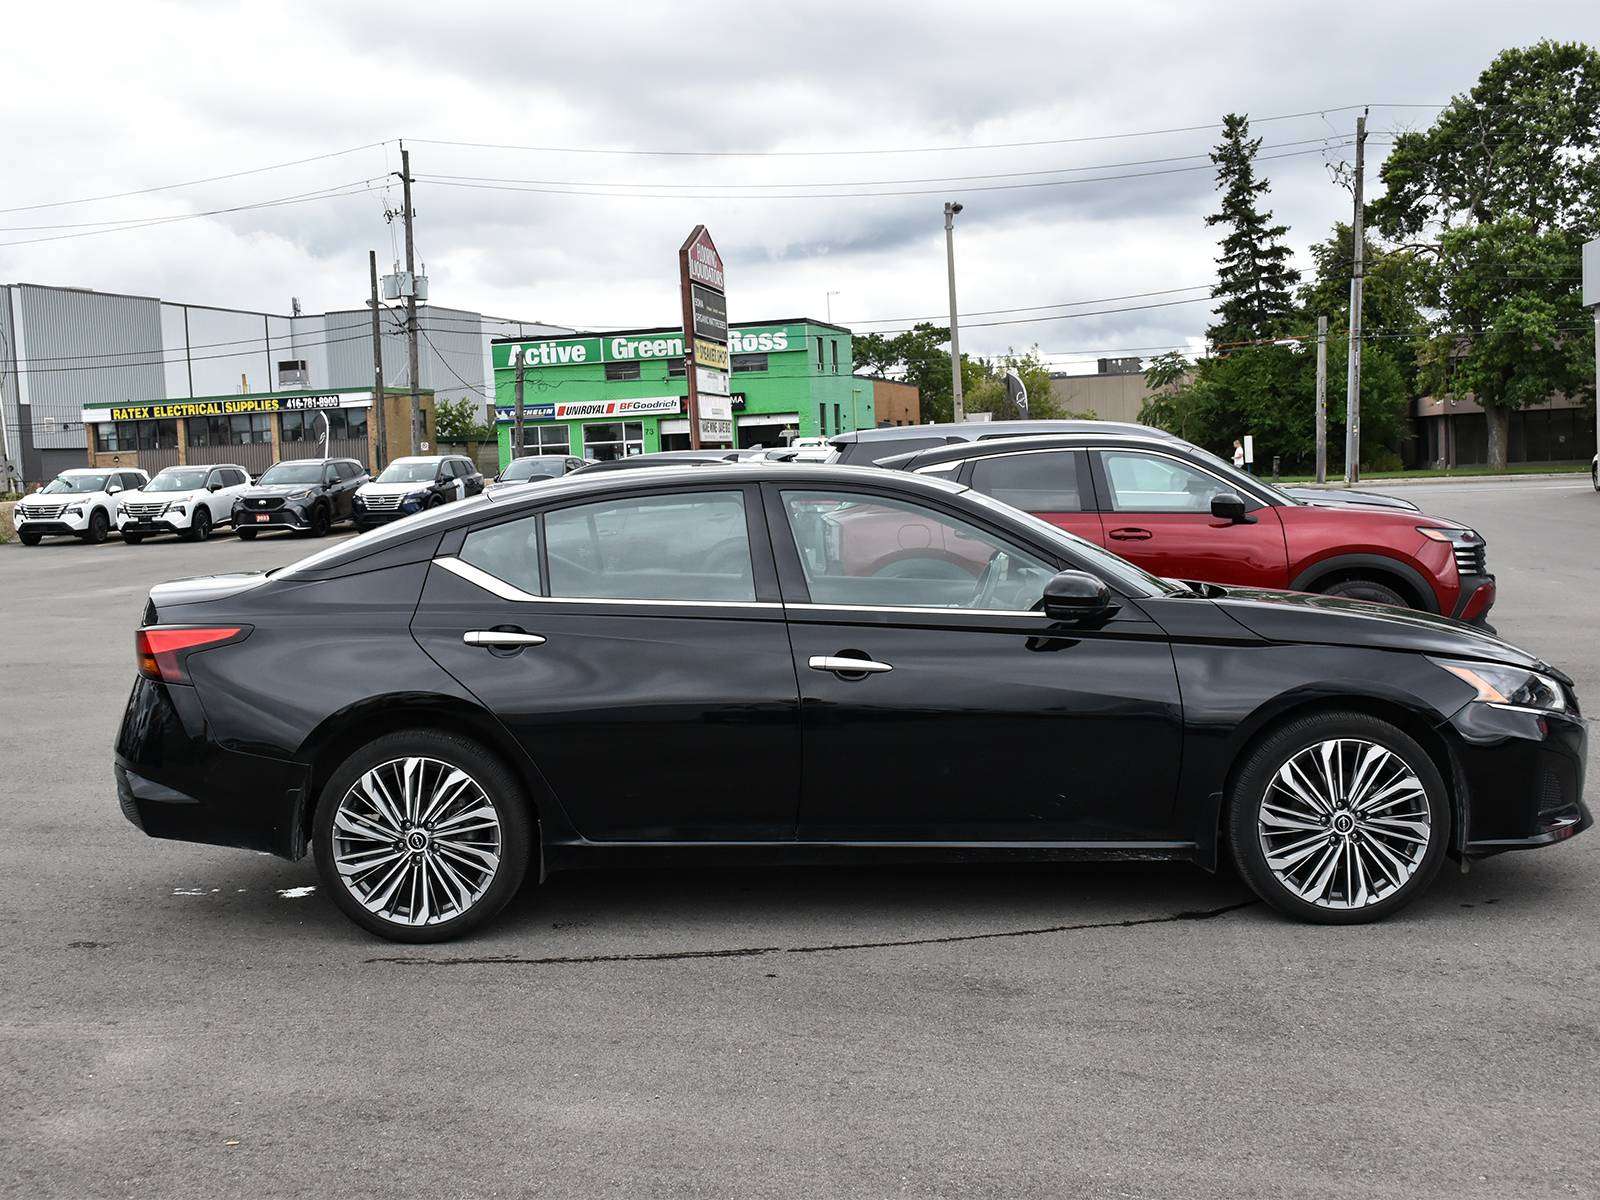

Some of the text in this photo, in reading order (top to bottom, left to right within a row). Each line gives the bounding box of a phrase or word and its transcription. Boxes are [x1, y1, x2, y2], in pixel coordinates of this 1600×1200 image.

[508, 342, 586, 366] Active
[611, 337, 683, 360] Green
[728, 330, 788, 352] Ross
[113, 395, 338, 420] RATEX ELECTRICAL SUPPLIES 416-781-8900
[565, 403, 606, 416] UNIROYAL
[619, 400, 677, 410] BFGoodrich
